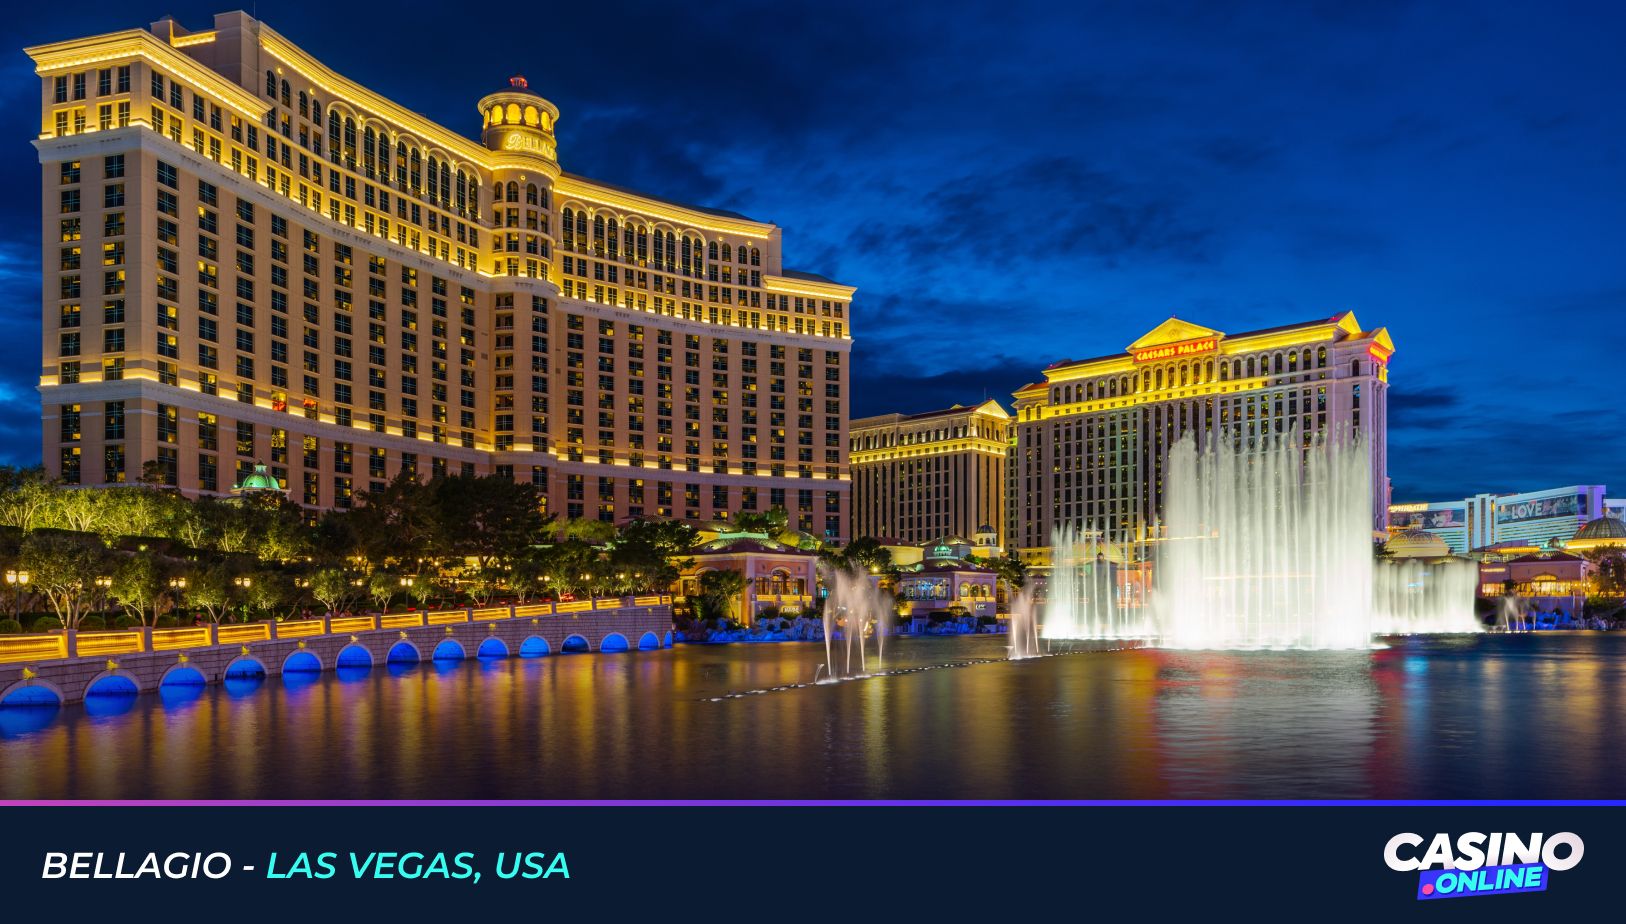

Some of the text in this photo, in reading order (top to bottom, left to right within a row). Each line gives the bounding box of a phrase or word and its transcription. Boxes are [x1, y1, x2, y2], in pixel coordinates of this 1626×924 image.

[1136, 340, 1214, 361] CAESARS PALACE
[1511, 502, 1543, 520] LOVE
